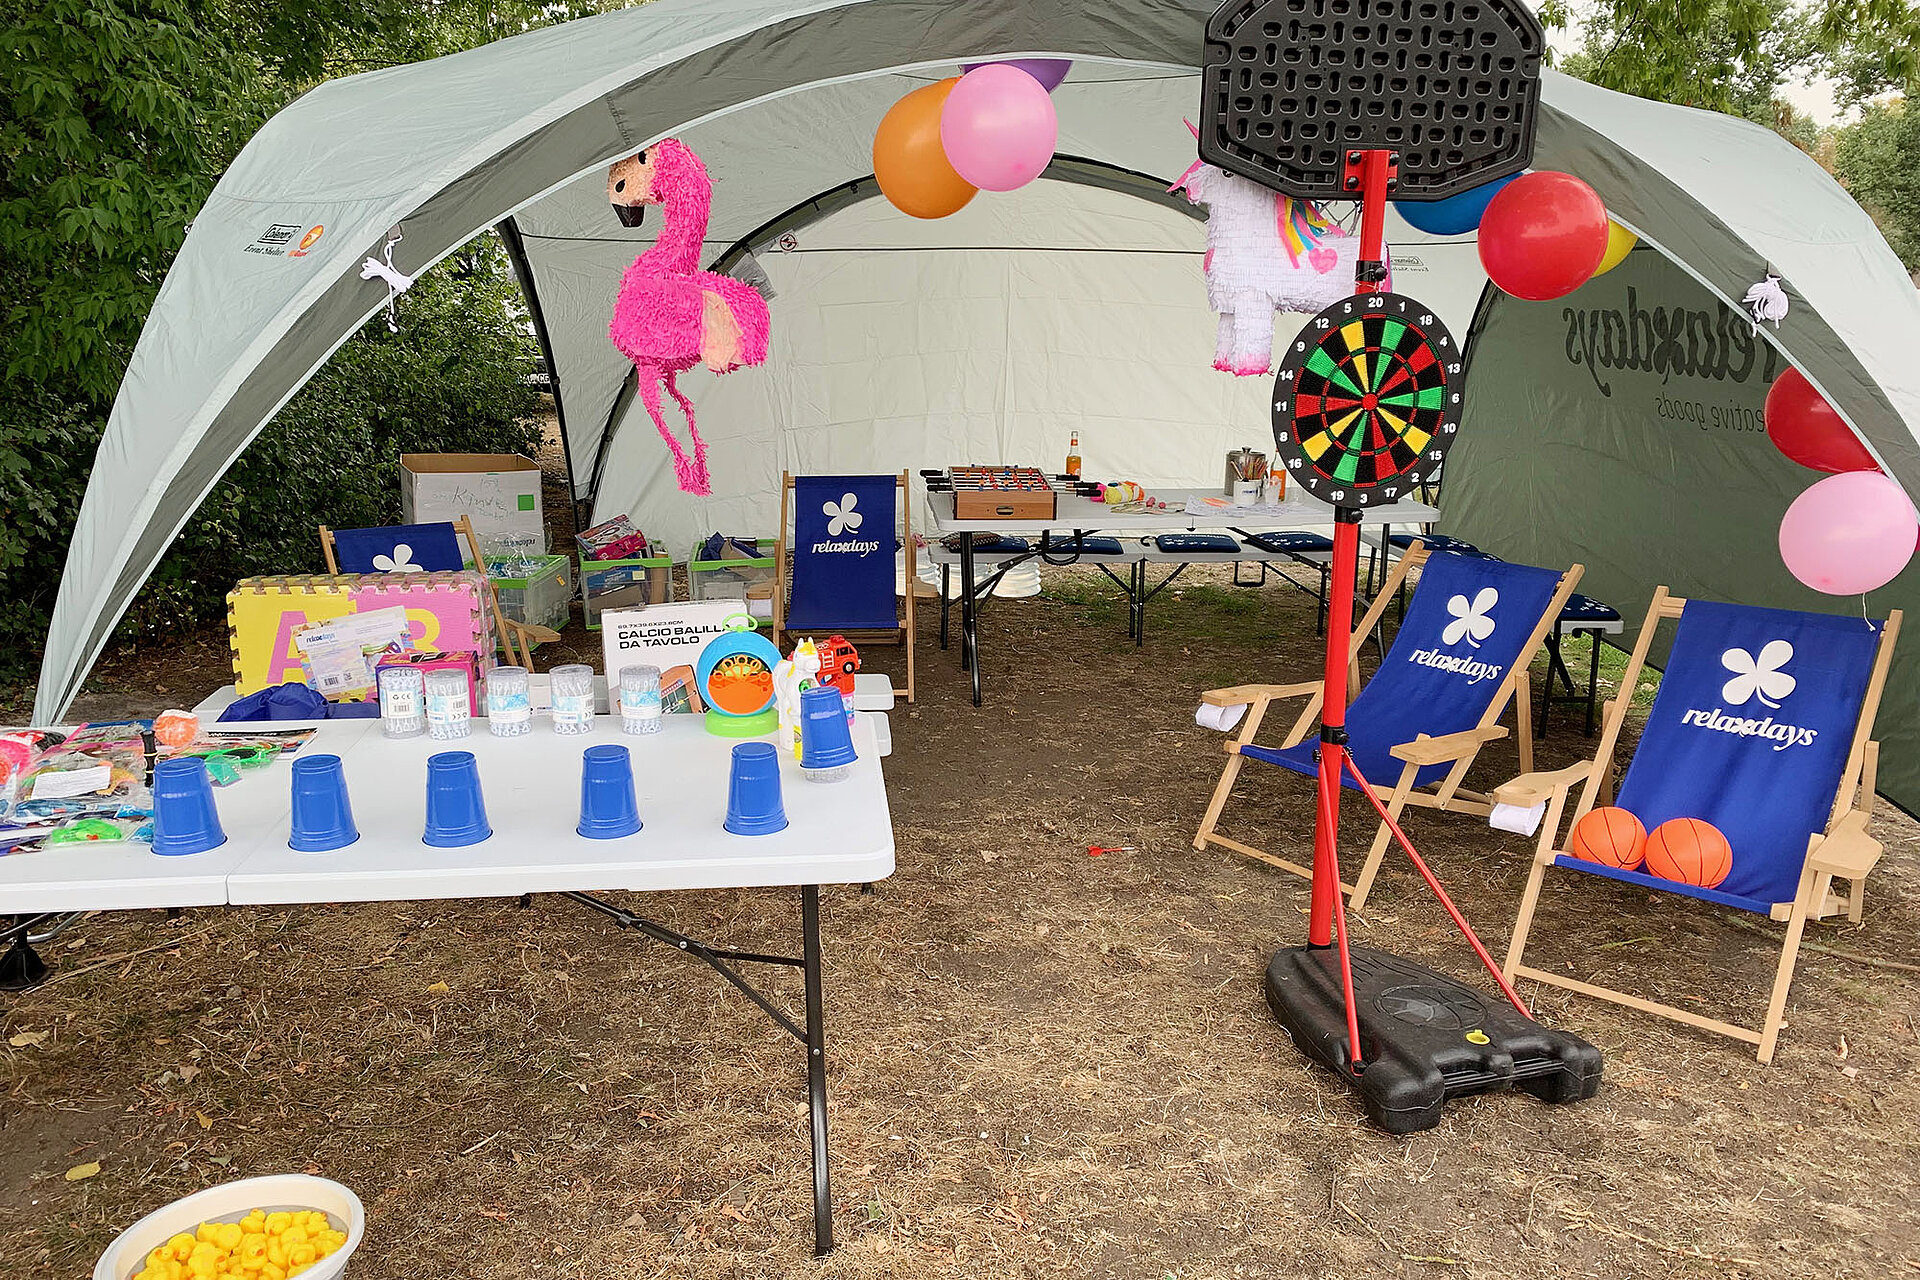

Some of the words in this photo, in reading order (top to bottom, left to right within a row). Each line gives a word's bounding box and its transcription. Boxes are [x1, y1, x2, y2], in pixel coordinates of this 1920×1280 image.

[1368, 297, 1383, 307] 20
[1399, 302, 1405, 312] 1
[1344, 303, 1352, 313] 5
[1315, 318, 1329, 328] 12
[1420, 315, 1432, 325] 18
[1440, 337, 1447, 346] 4
[1297, 342, 1305, 352] 9
[1448, 363, 1460, 374] 13
[1280, 370, 1294, 380] 14
[1452, 393, 1459, 403] 6
[1275, 401, 1287, 411] 11
[1443, 423, 1456, 433] 10
[1280, 432, 1287, 442] 8
[1429, 451, 1442, 460] 15
[1288, 458, 1302, 469] 16
[1412, 473, 1419, 482] 2
[1310, 479, 1317, 488] 7
[1331, 491, 1344, 500] 19
[1385, 487, 1397, 497] 17
[1360, 494, 1367, 503] 3
[812, 539, 879, 557] relaxdays
[618, 627, 671, 640] CALCIO
[619, 640, 641, 649] DA
[643, 636, 700, 647] TAVOLO
[1408, 648, 1503, 685] relaxdays
[1681, 708, 1819, 751] relaxdays
